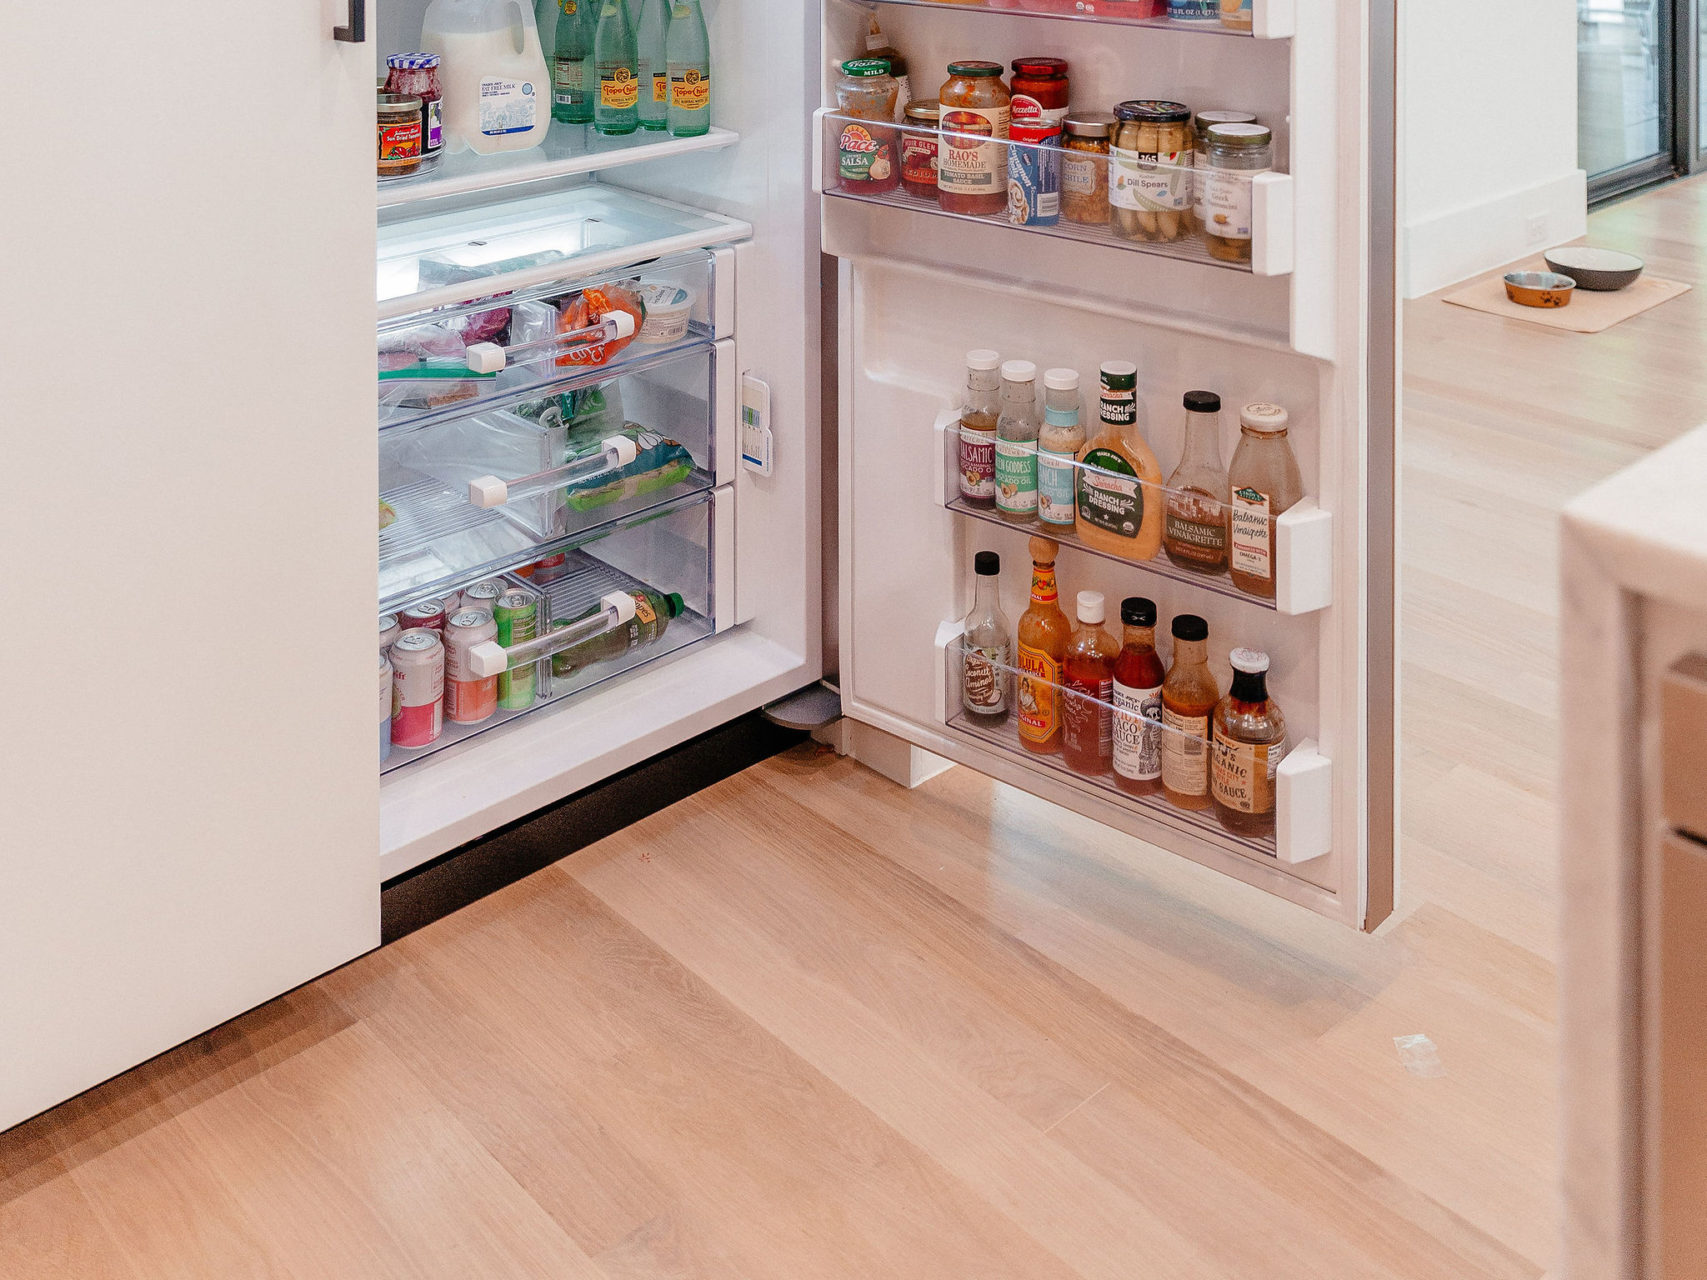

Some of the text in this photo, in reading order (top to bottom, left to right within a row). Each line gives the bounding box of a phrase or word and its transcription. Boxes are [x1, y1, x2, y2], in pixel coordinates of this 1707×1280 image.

[863, 68, 884, 76] MILD
[603, 83, 638, 96] Topo Chico
[655, 81, 667, 92] To
[673, 85, 709, 97] Topo Chico
[840, 133, 877, 153] Pace
[918, 141, 936, 151] GLEN
[841, 157, 869, 166] SALSA
[948, 149, 979, 161] RAO'S
[1140, 154, 1156, 162] 365
[943, 158, 986, 169] HOMEMADE
[1009, 144, 1032, 187] Cinnamon
[944, 171, 966, 179] TOMATO
[1127, 178, 1168, 188] Dill Spears
[1006, 460, 1032, 473] GODDESS
[1092, 475, 1123, 492] Sriracha
[1094, 491, 1120, 505] RANCH
[1088, 495, 1125, 515] DRESSING
[1232, 509, 1268, 526] Balsamic
[1174, 521, 1216, 537] BALSAMIC
[1232, 524, 1268, 540] Vinaigrette
[1168, 526, 1223, 546] VINAIGRETTE
[1019, 655, 1046, 672] LULA
[966, 675, 994, 689] Aminos
[1220, 782, 1247, 799] SAUCE
